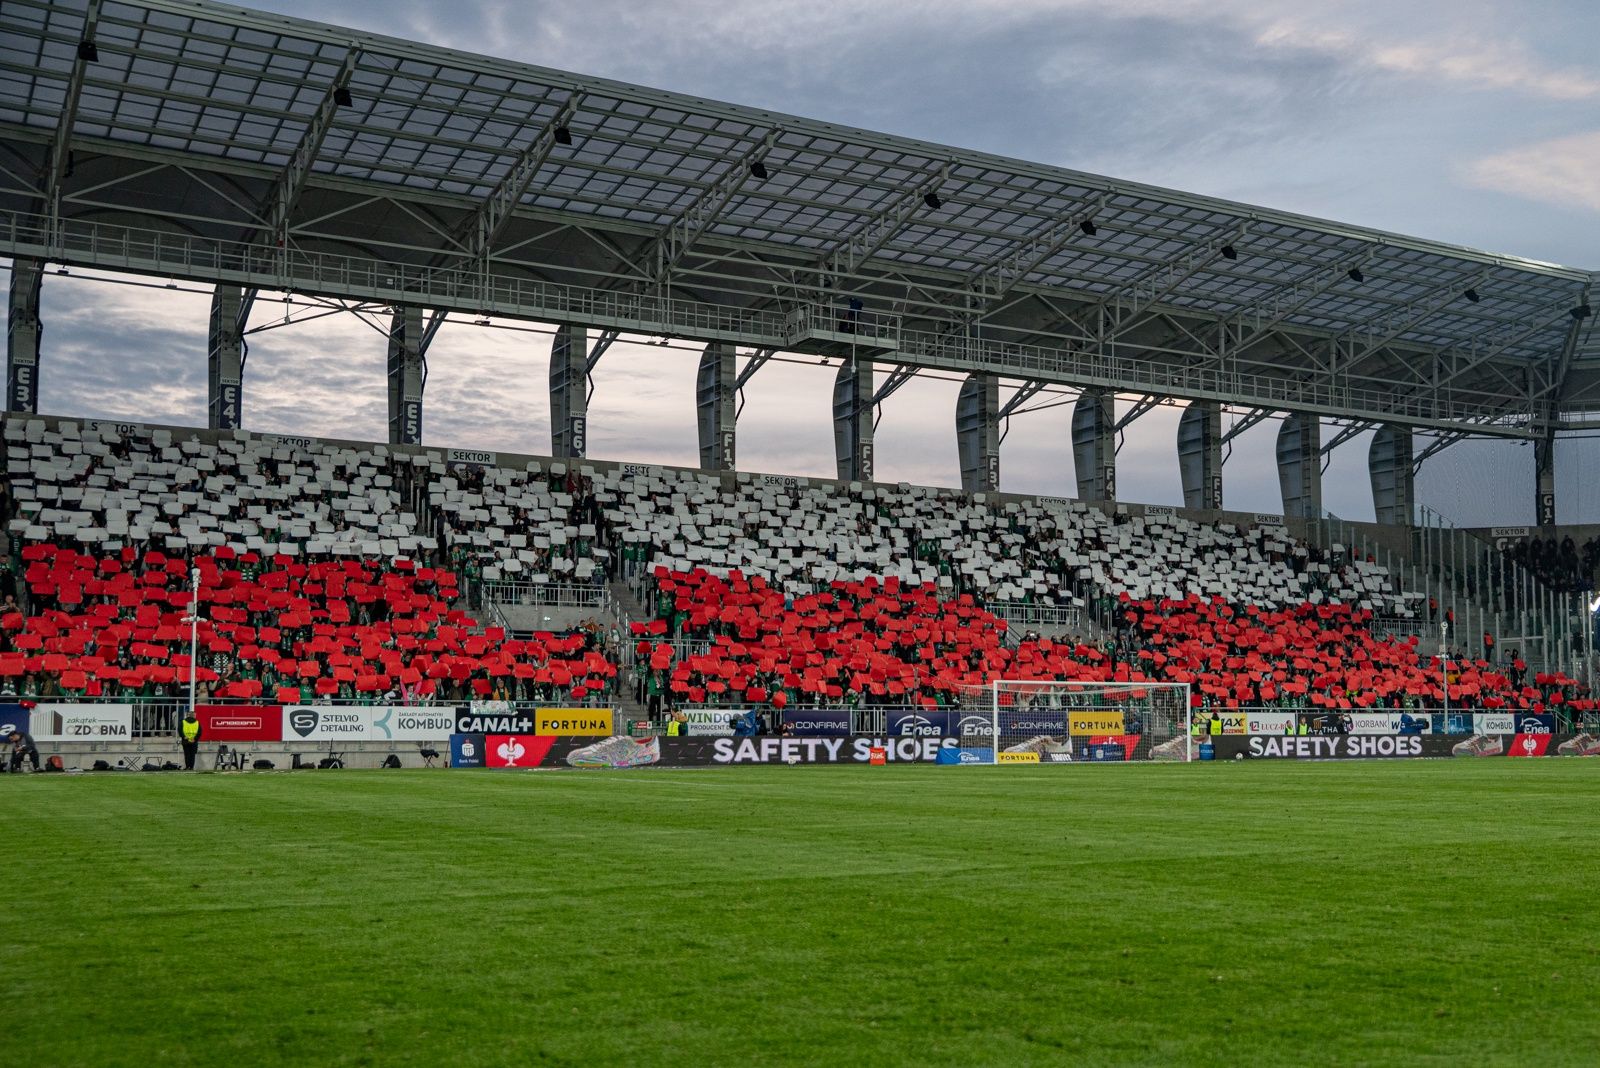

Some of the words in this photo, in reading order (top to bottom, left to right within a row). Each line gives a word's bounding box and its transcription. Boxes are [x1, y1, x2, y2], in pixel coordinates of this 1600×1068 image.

[91, 421, 137, 434] STOR
[277, 437, 311, 448] EKTOR
[453, 451, 491, 463] SEKTOR
[1148, 506, 1173, 516] SEKTOR
[1257, 515, 1280, 524] SEKTOR
[1495, 528, 1525, 536] SEKTOR
[322, 714, 359, 723] STELVIO
[398, 718, 452, 729] KOMBUD
[321, 724, 364, 732] DETAILING
[458, 717, 532, 732] CANAL+
[542, 720, 606, 729] FORTUNA
[1074, 721, 1120, 729] FORTUNA
[1355, 720, 1388, 728] KORBANK
[1486, 721, 1513, 730] KOMBUD
[1524, 724, 1550, 734] Enea
[66, 725, 127, 735] OZDOBNA
[901, 723, 941, 736] Enea
[963, 723, 1001, 736] Enea
[713, 738, 845, 762] SAFETY
[1249, 736, 1340, 757] SAFETY
[1347, 735, 1423, 756] SHOES
